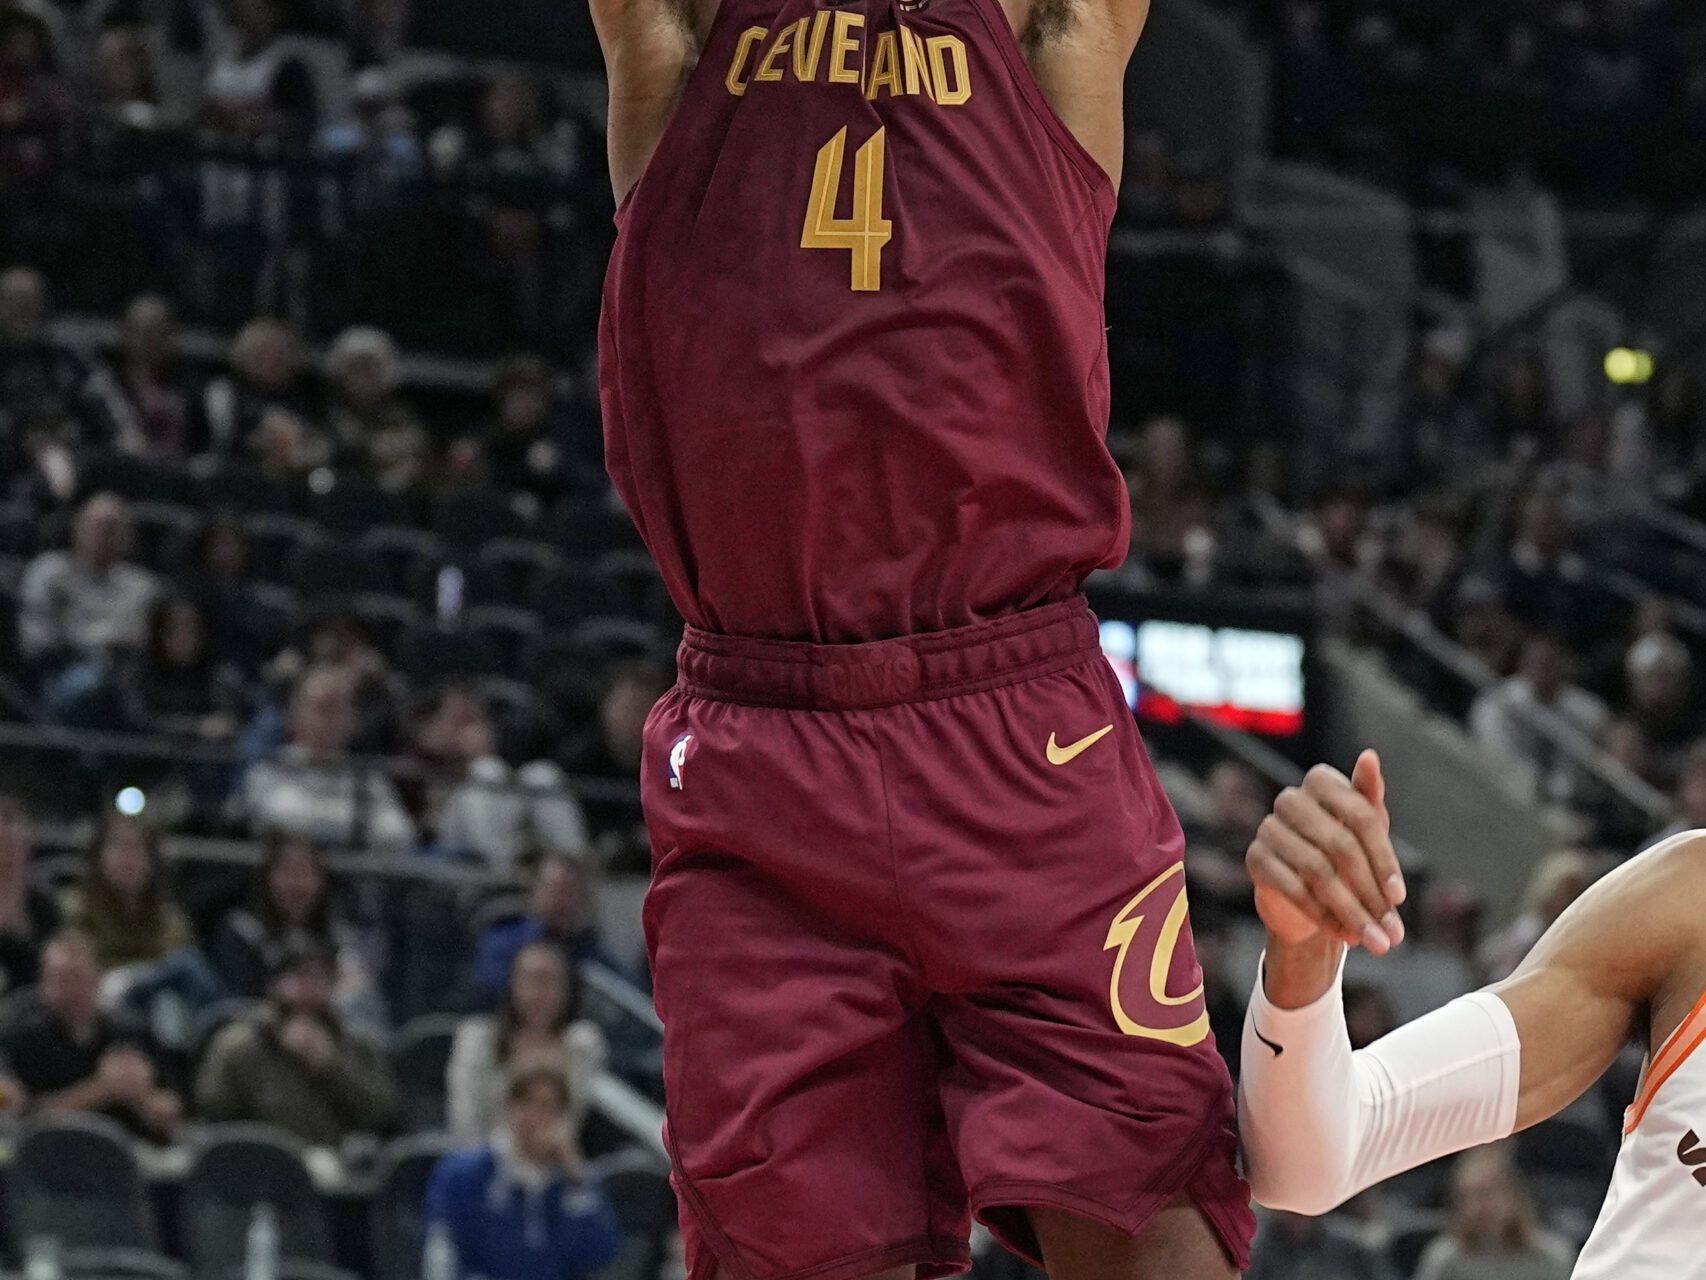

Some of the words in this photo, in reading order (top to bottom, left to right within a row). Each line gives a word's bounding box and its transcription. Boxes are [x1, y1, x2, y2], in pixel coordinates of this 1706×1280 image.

[724, 9, 972, 106] CEVEAND
[800, 124, 892, 291] 4
[828, 658, 915, 700] CAVS
